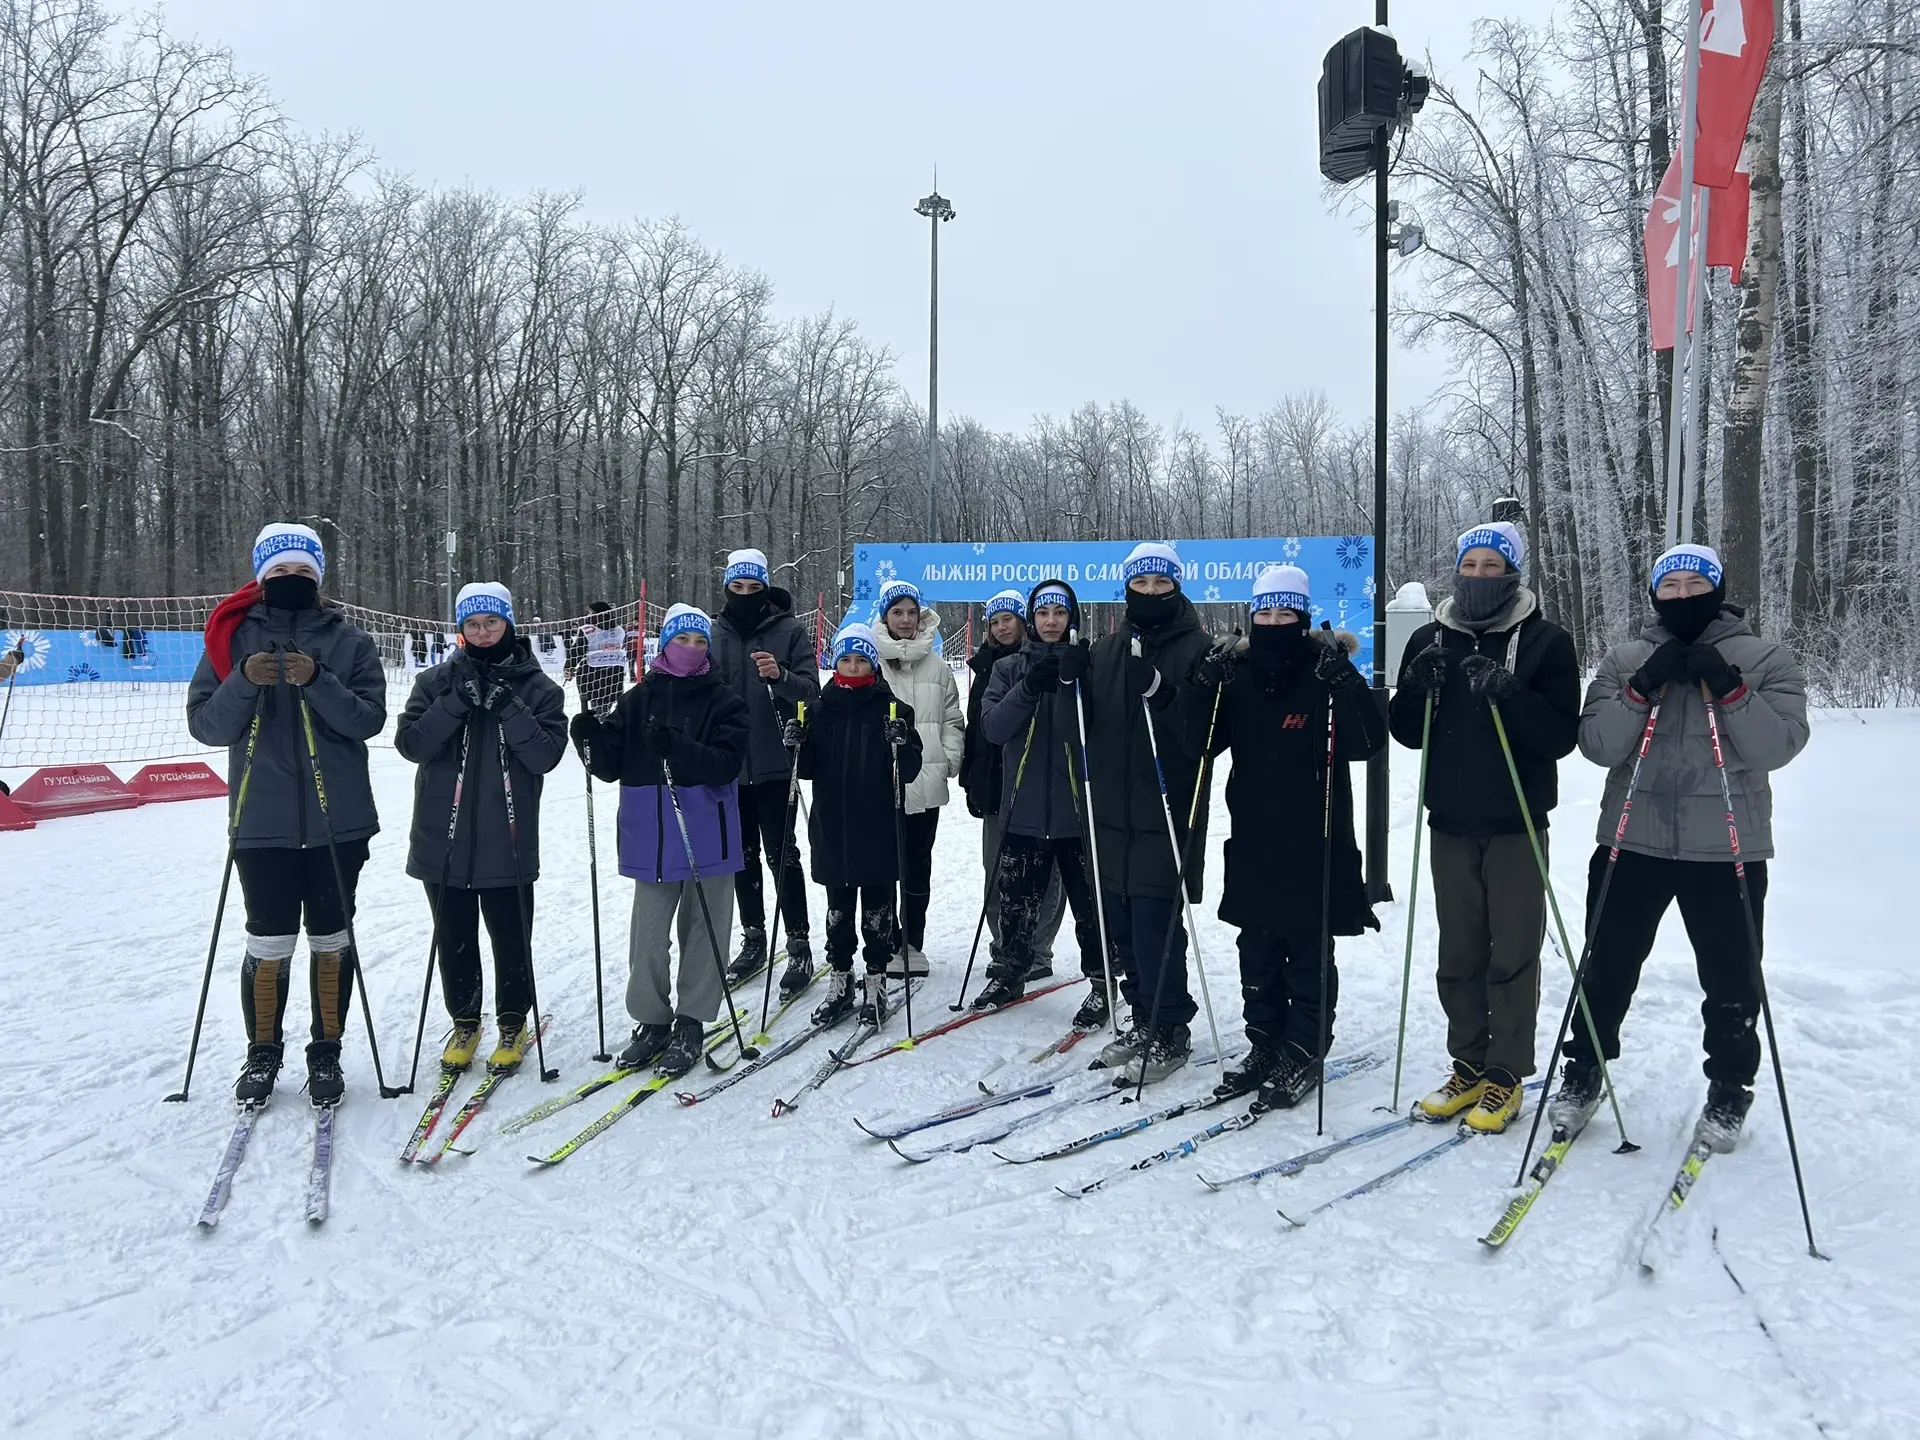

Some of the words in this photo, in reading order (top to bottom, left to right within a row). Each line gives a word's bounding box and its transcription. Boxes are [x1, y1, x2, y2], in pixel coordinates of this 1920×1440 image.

[921, 563, 987, 581] ЛЫЖНЯ
[991, 561, 1063, 581] РОССИИ
[1067, 561, 1079, 580] В
[43, 776, 54, 786] ГУ
